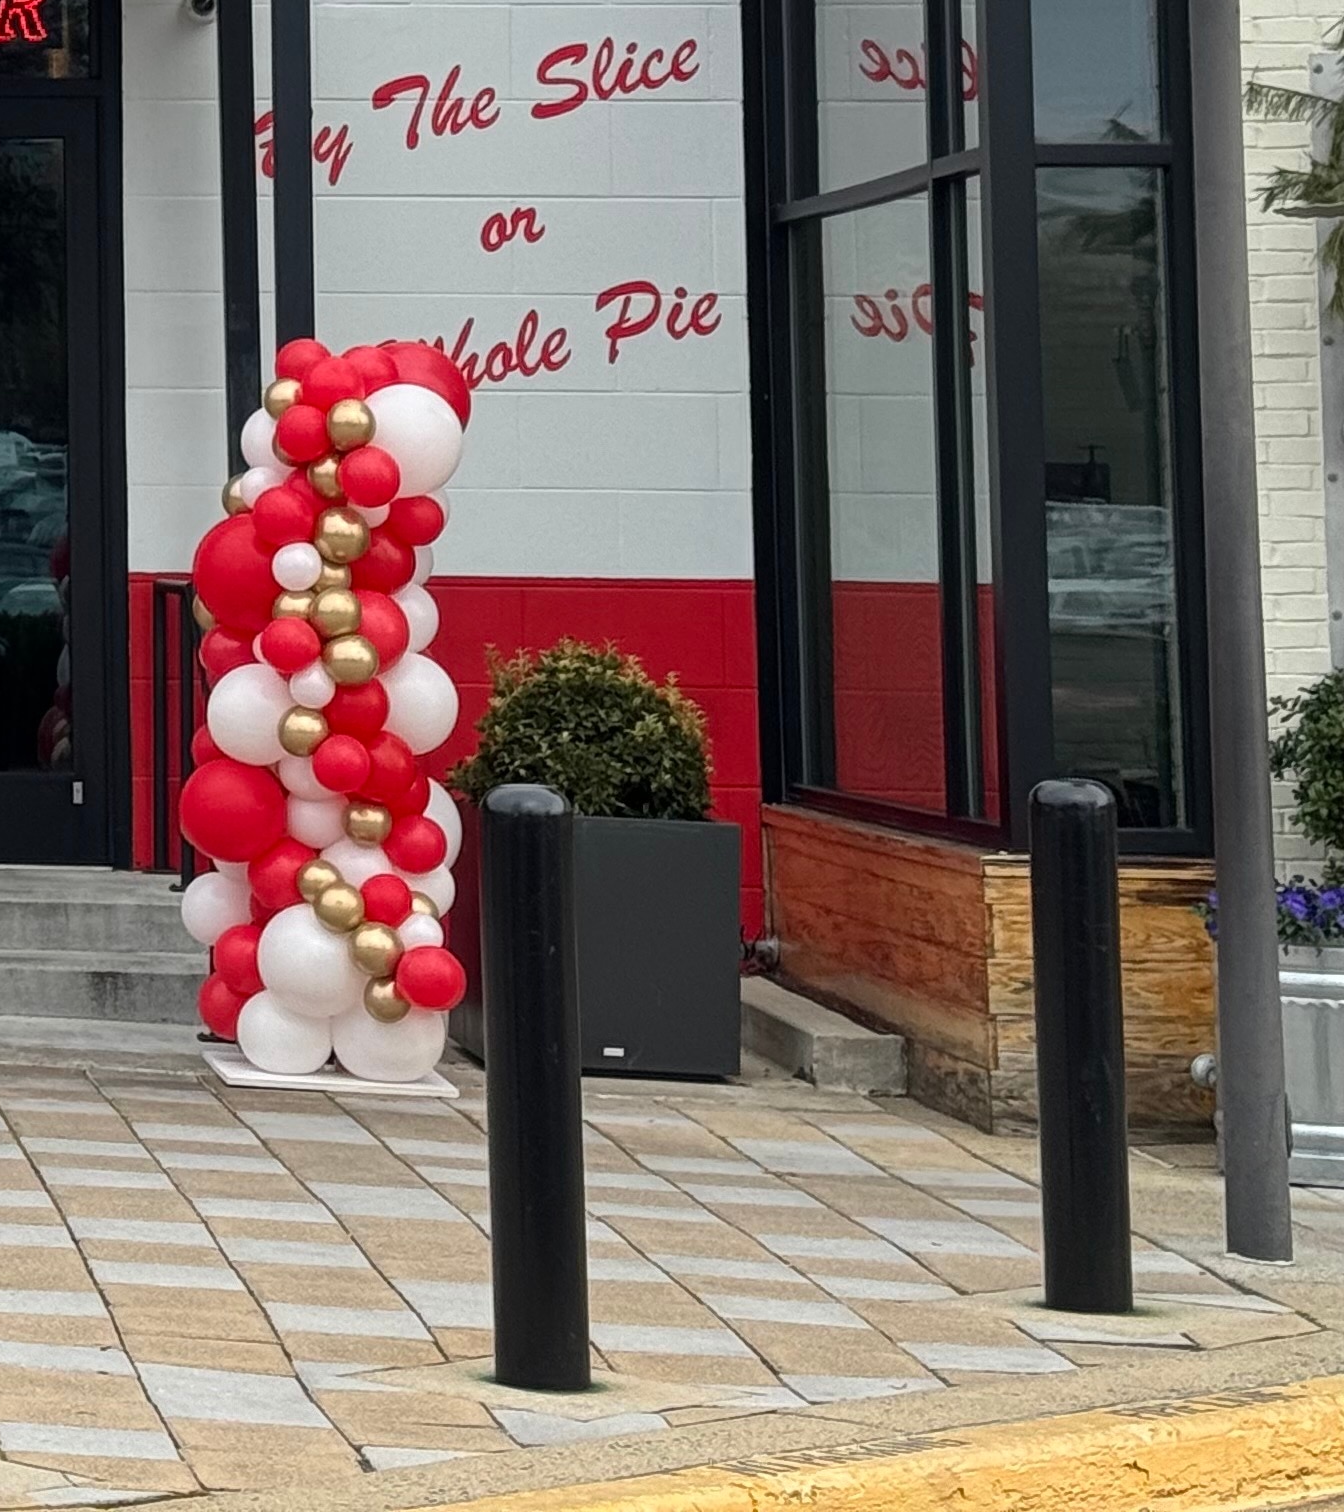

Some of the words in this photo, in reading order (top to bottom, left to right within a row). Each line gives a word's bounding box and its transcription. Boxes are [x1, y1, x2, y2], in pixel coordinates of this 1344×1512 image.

[371, 65, 500, 150] The
[530, 37, 700, 119] Slice
[479, 207, 545, 252] or
[376, 309, 573, 389] hole
[595, 279, 723, 364] Pie
